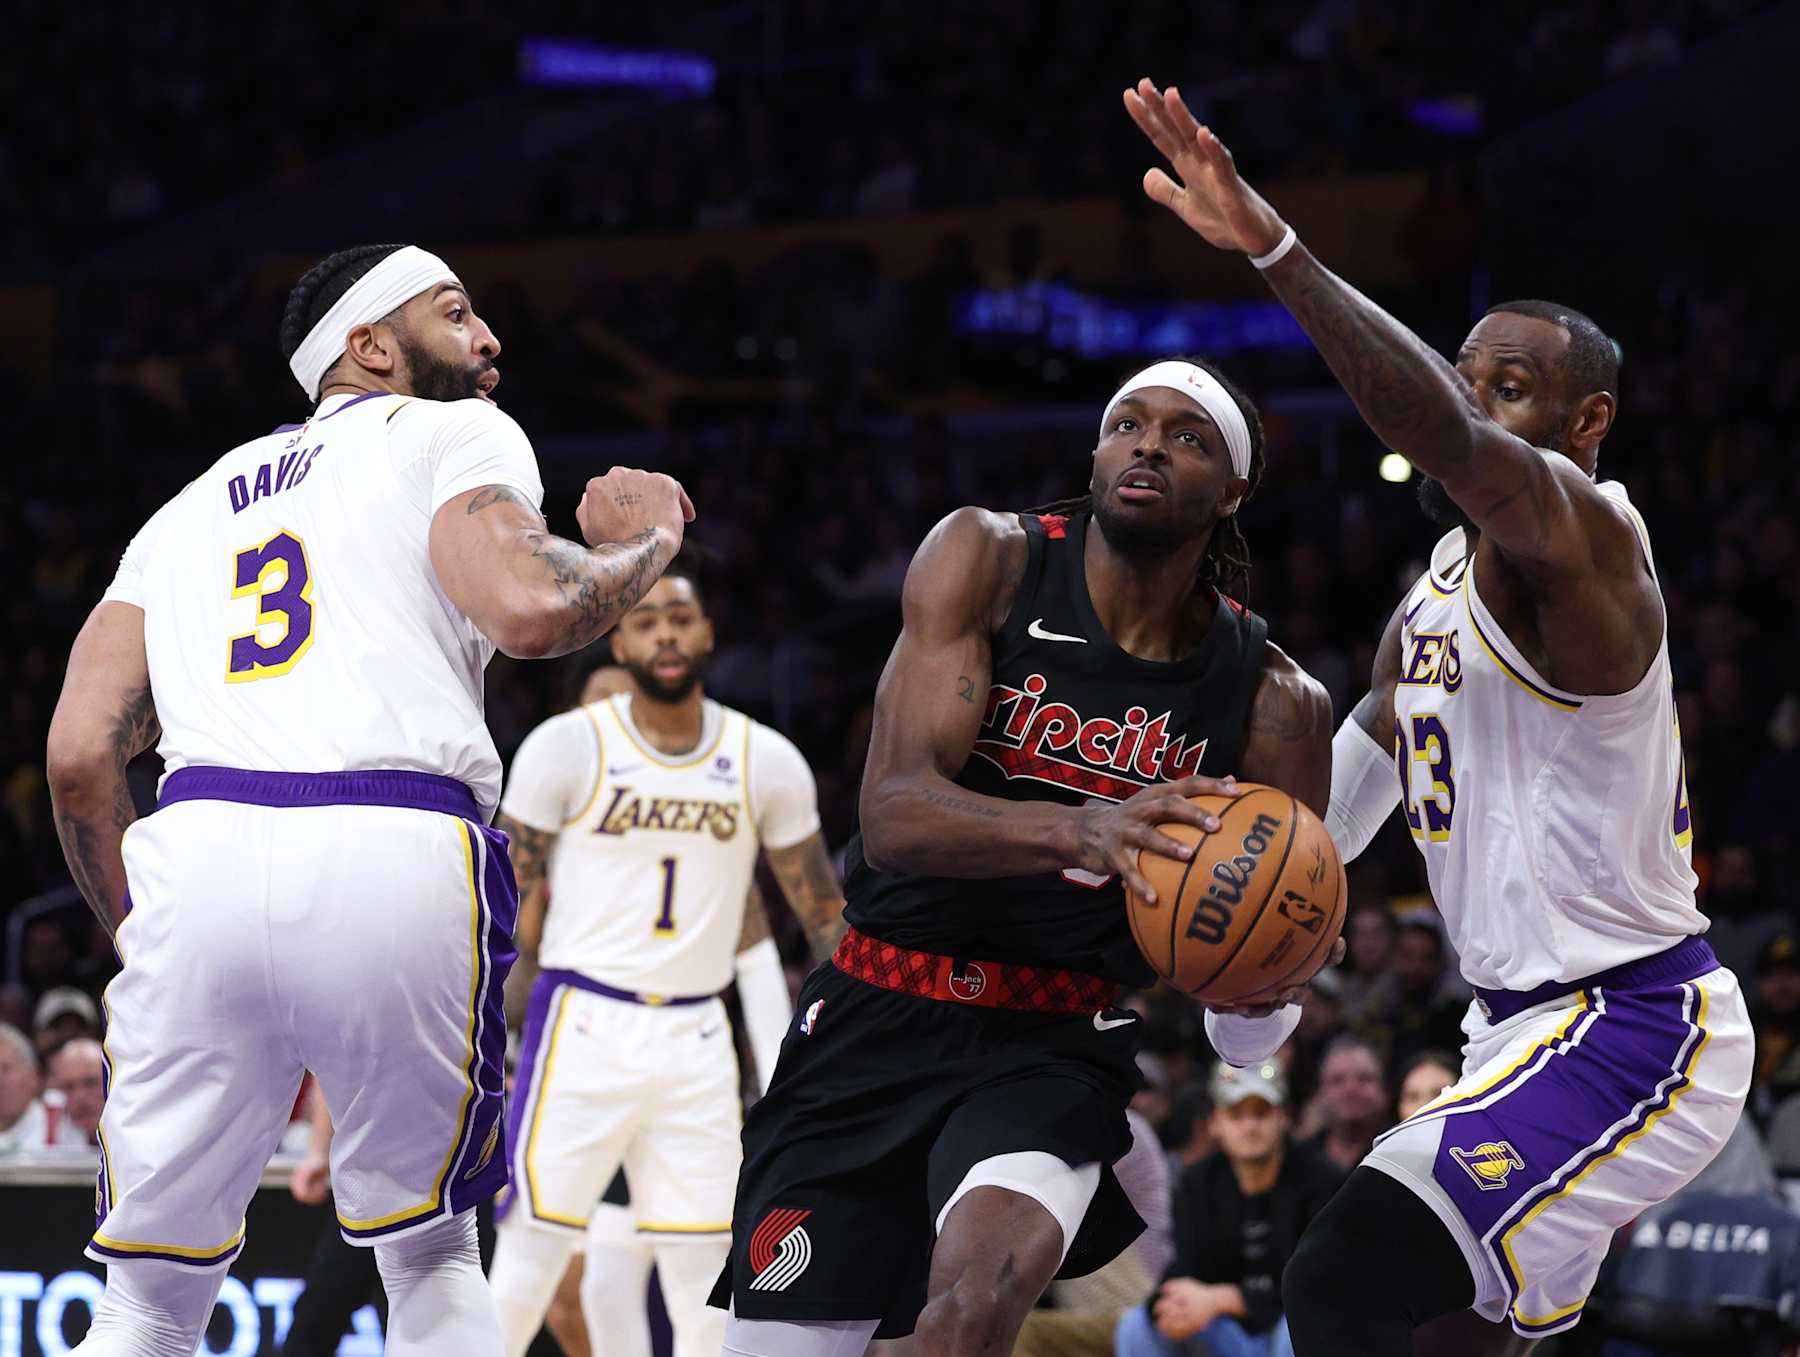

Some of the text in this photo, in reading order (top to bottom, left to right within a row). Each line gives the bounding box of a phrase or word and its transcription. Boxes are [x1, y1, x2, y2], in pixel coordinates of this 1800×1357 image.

[228, 443, 324, 515] DAVIS
[224, 527, 317, 684] 3
[592, 786, 742, 842] LAKERS
[653, 854, 680, 939] 1
[1184, 813, 1282, 946] Wilson
[1666, 1219, 1771, 1254] DELTA
